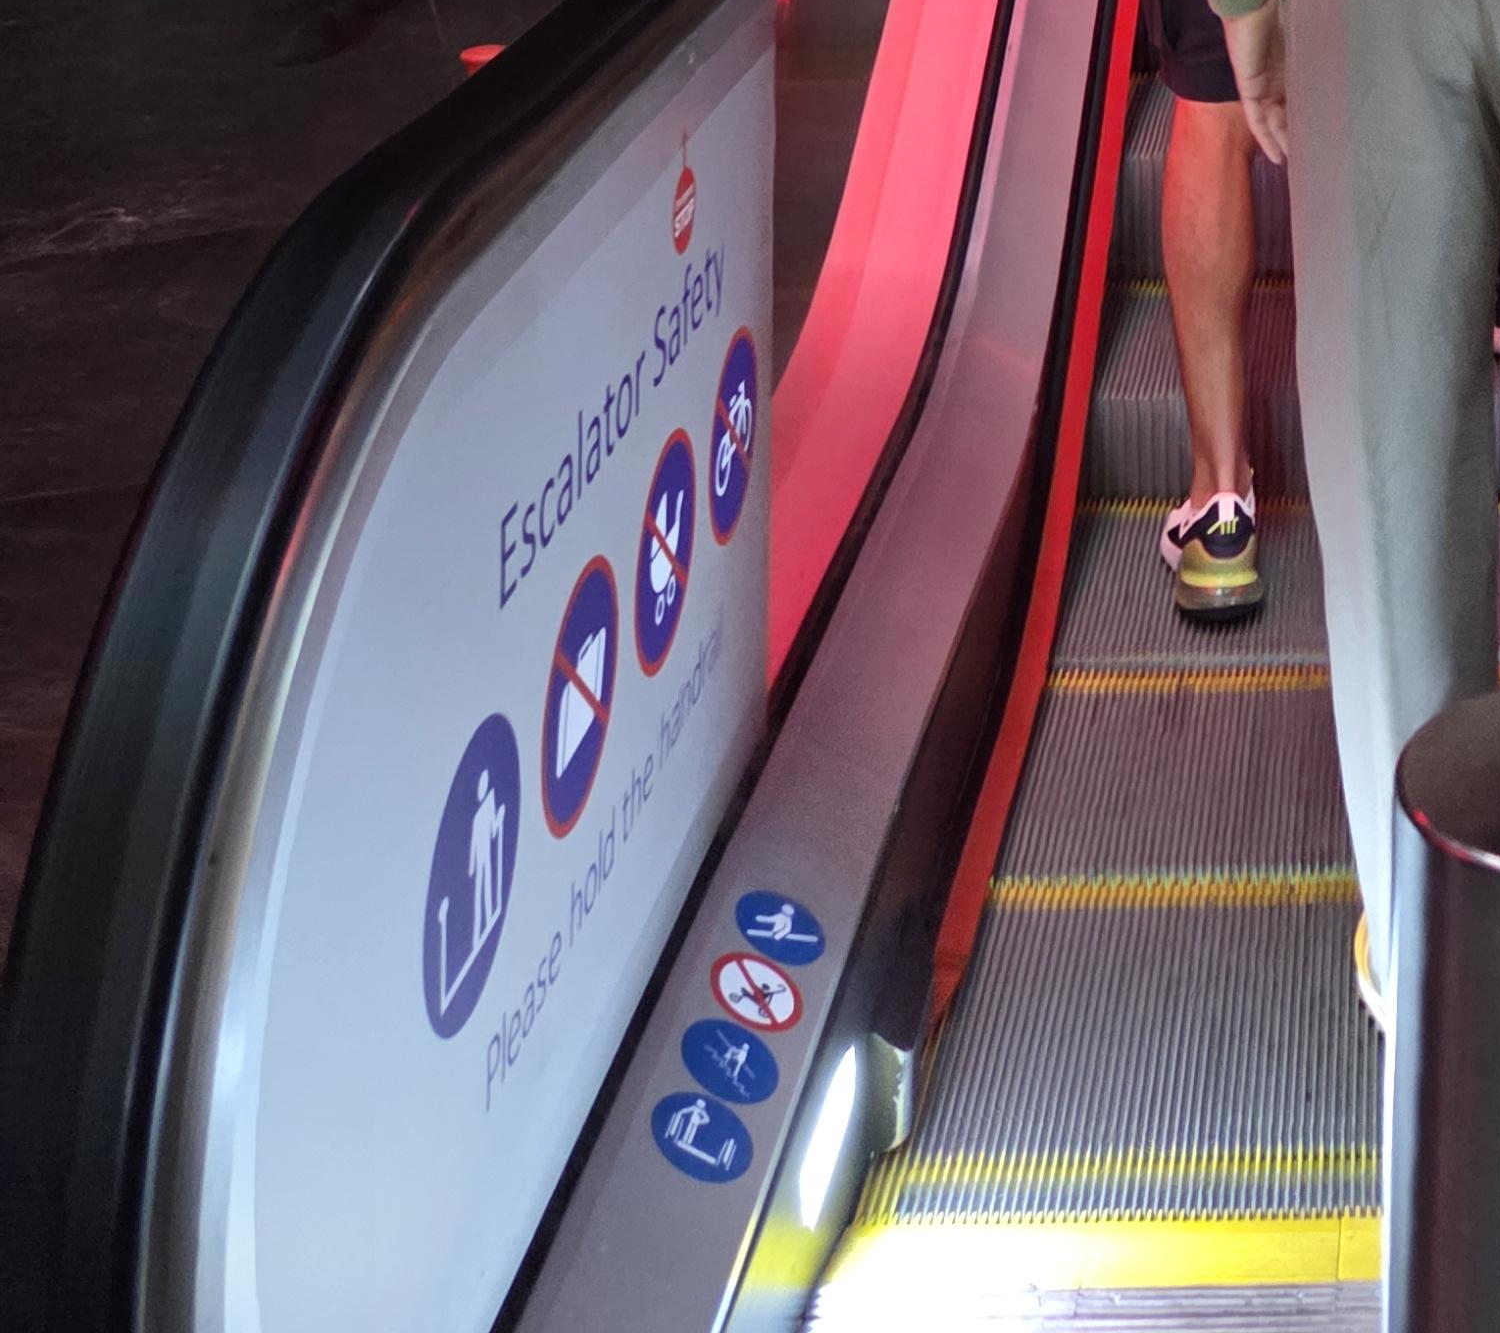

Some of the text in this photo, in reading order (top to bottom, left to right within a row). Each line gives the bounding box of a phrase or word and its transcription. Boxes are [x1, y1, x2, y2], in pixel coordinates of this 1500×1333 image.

[499, 239, 725, 611] Escalator Safety
[485, 930, 562, 1112] Please
[568, 806, 617, 948] hold
[623, 754, 654, 844] the
